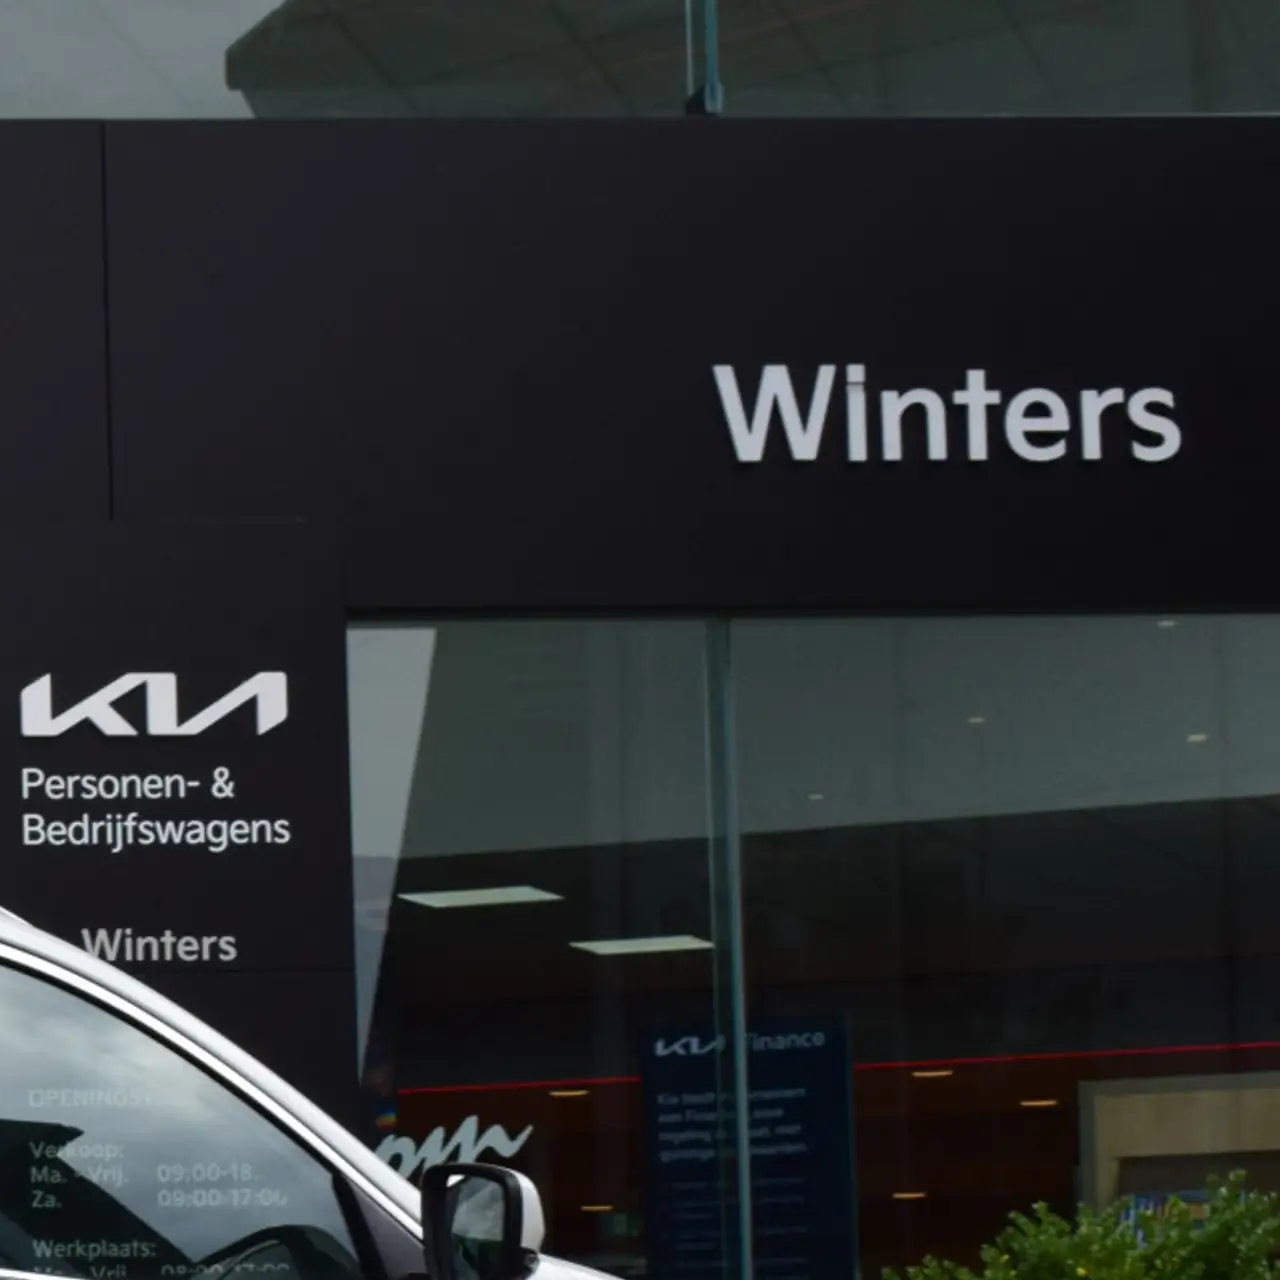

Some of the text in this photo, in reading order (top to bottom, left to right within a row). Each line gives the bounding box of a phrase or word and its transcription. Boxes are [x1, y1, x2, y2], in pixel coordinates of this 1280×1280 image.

[712, 363, 1182, 462] Winters
[20, 671, 288, 737] KIA
[21, 766, 236, 800] Personen- &
[22, 812, 291, 853] Bedrijfswagens
[81, 928, 238, 961] Winters
[32, 1239, 156, 1262] Werkplaats:
